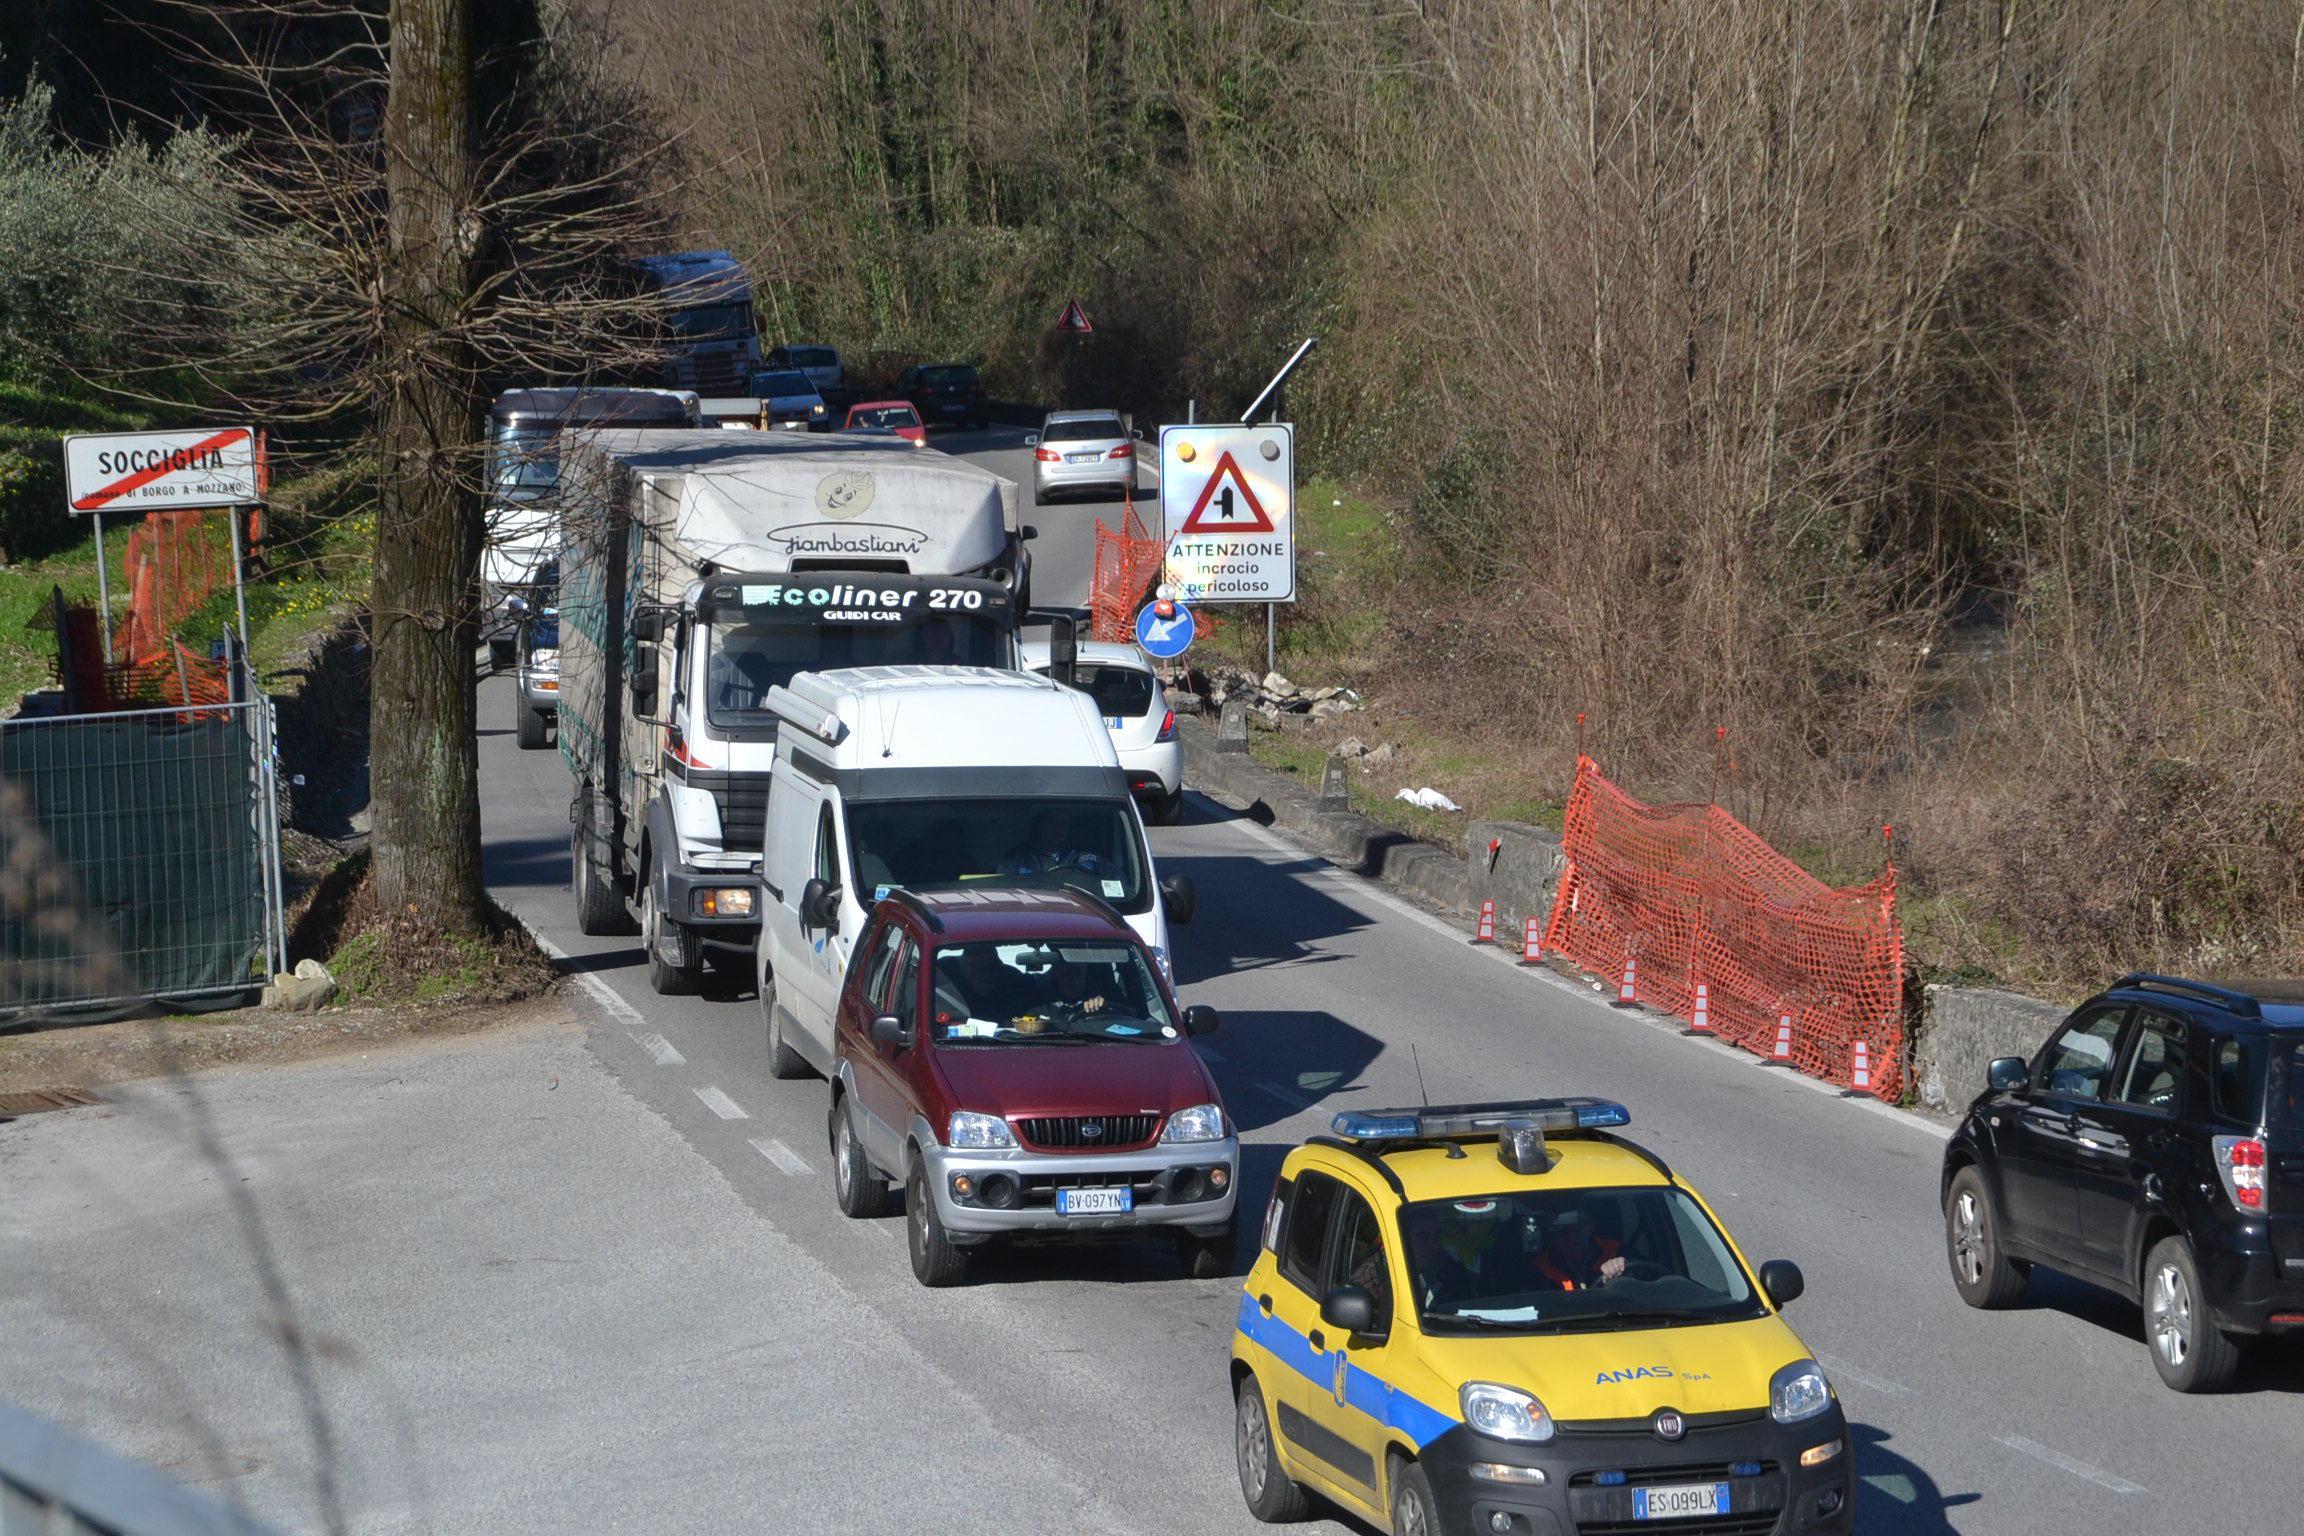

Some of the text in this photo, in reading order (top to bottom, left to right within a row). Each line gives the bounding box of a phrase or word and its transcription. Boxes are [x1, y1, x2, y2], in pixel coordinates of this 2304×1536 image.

[98, 446, 223, 474] SOCCIGLIA
[126, 487, 137, 498] di
[142, 485, 176, 498] BORGO
[183, 485, 190, 495] A
[1173, 543, 1284, 557] ATTENZIONE
[1197, 561, 1259, 574] incrocio
[1187, 579, 1269, 594] pericoloso
[928, 589, 982, 609] 270
[823, 610, 901, 621] GUIDI CAR
[1596, 1366, 1674, 1384] ANAS
